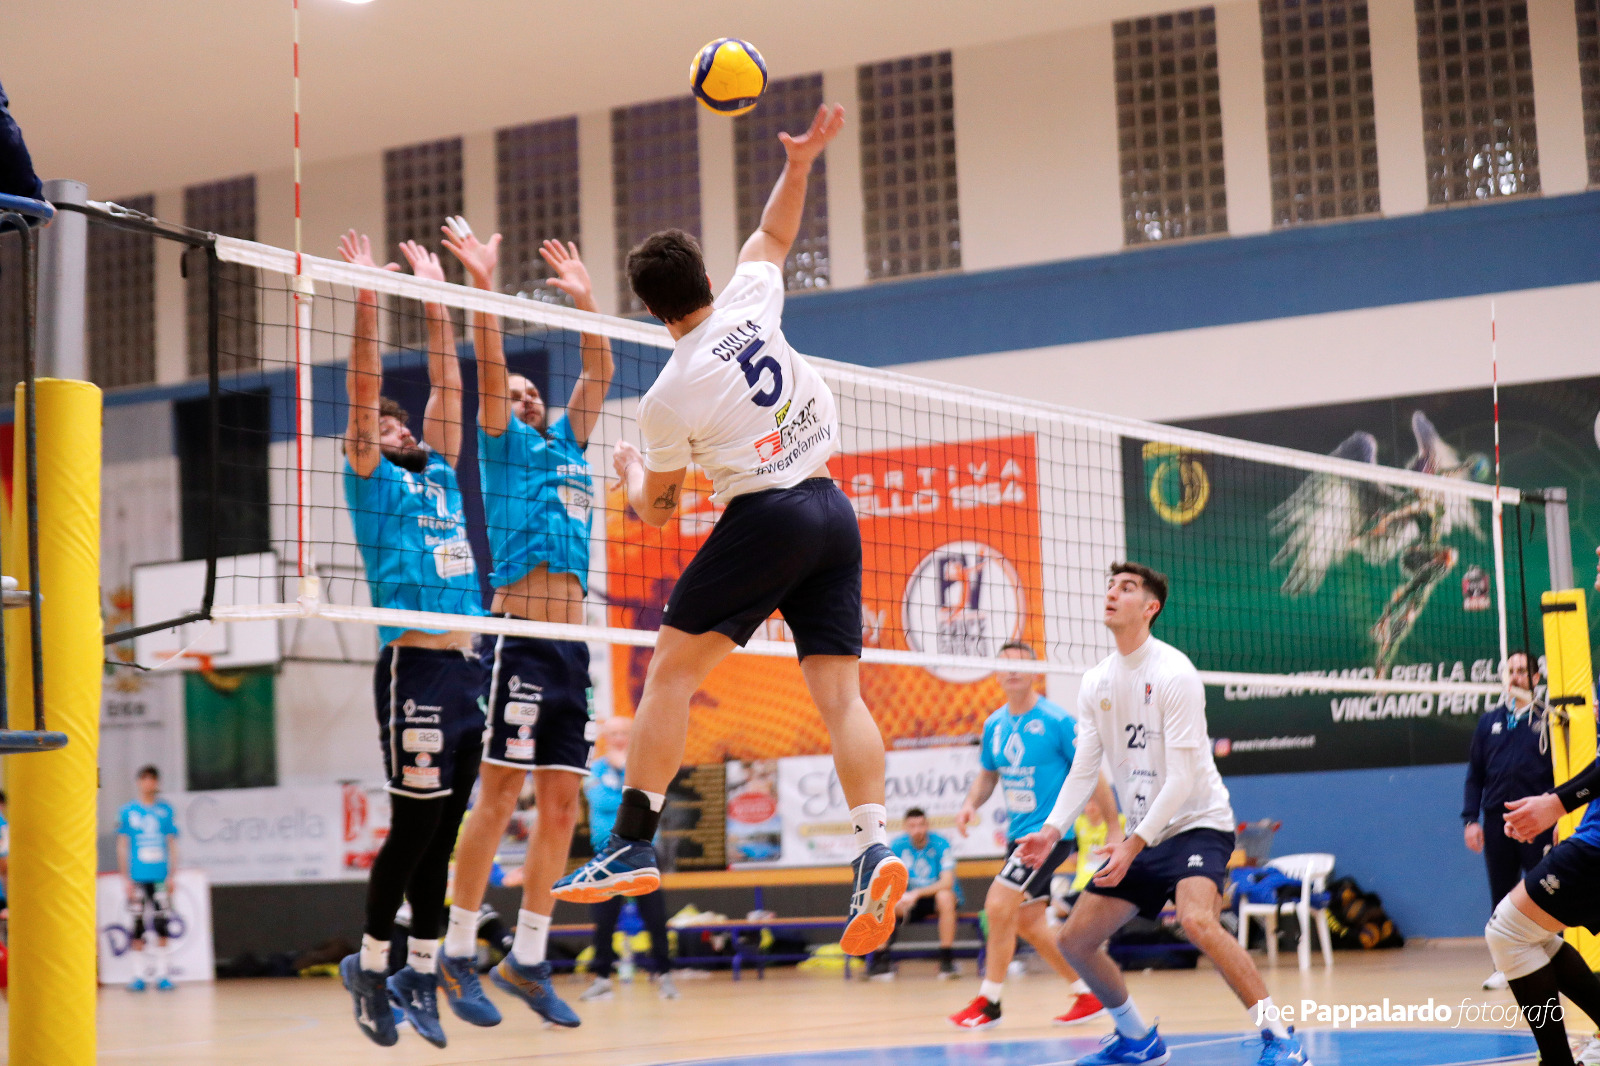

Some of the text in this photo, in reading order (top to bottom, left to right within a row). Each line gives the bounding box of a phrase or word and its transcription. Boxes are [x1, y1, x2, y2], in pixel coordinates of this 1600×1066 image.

[712, 320, 762, 362] CIULLA
[736, 338, 783, 408] 5
[850, 488, 941, 520] ELLO
[1330, 692, 1434, 724] VINCIAMO
[1437, 691, 1479, 716] PER
[1125, 723, 1147, 750] 23
